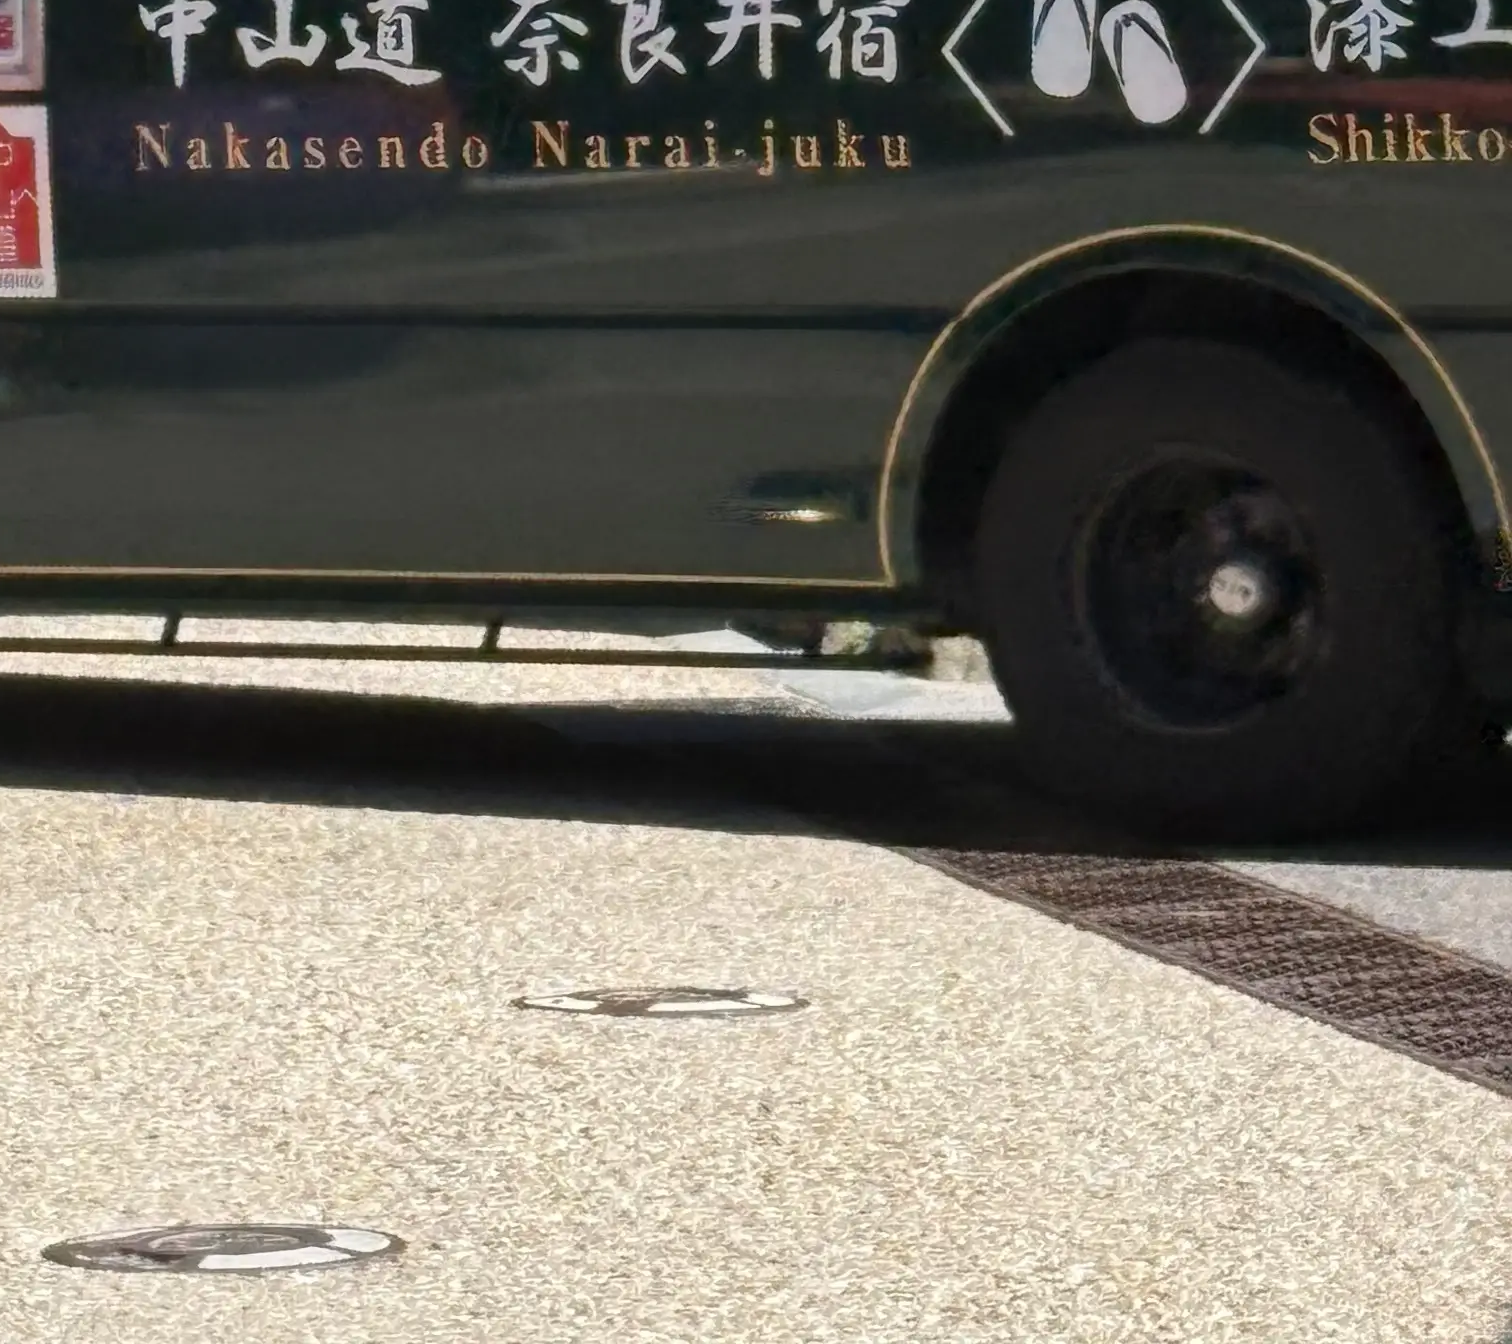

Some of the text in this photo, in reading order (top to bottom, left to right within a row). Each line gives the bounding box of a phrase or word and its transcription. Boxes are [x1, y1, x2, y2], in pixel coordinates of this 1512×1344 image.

[134, 118, 913, 178] Nakasendo Narai-juku
[1307, 112, 1512, 164] Shikko
